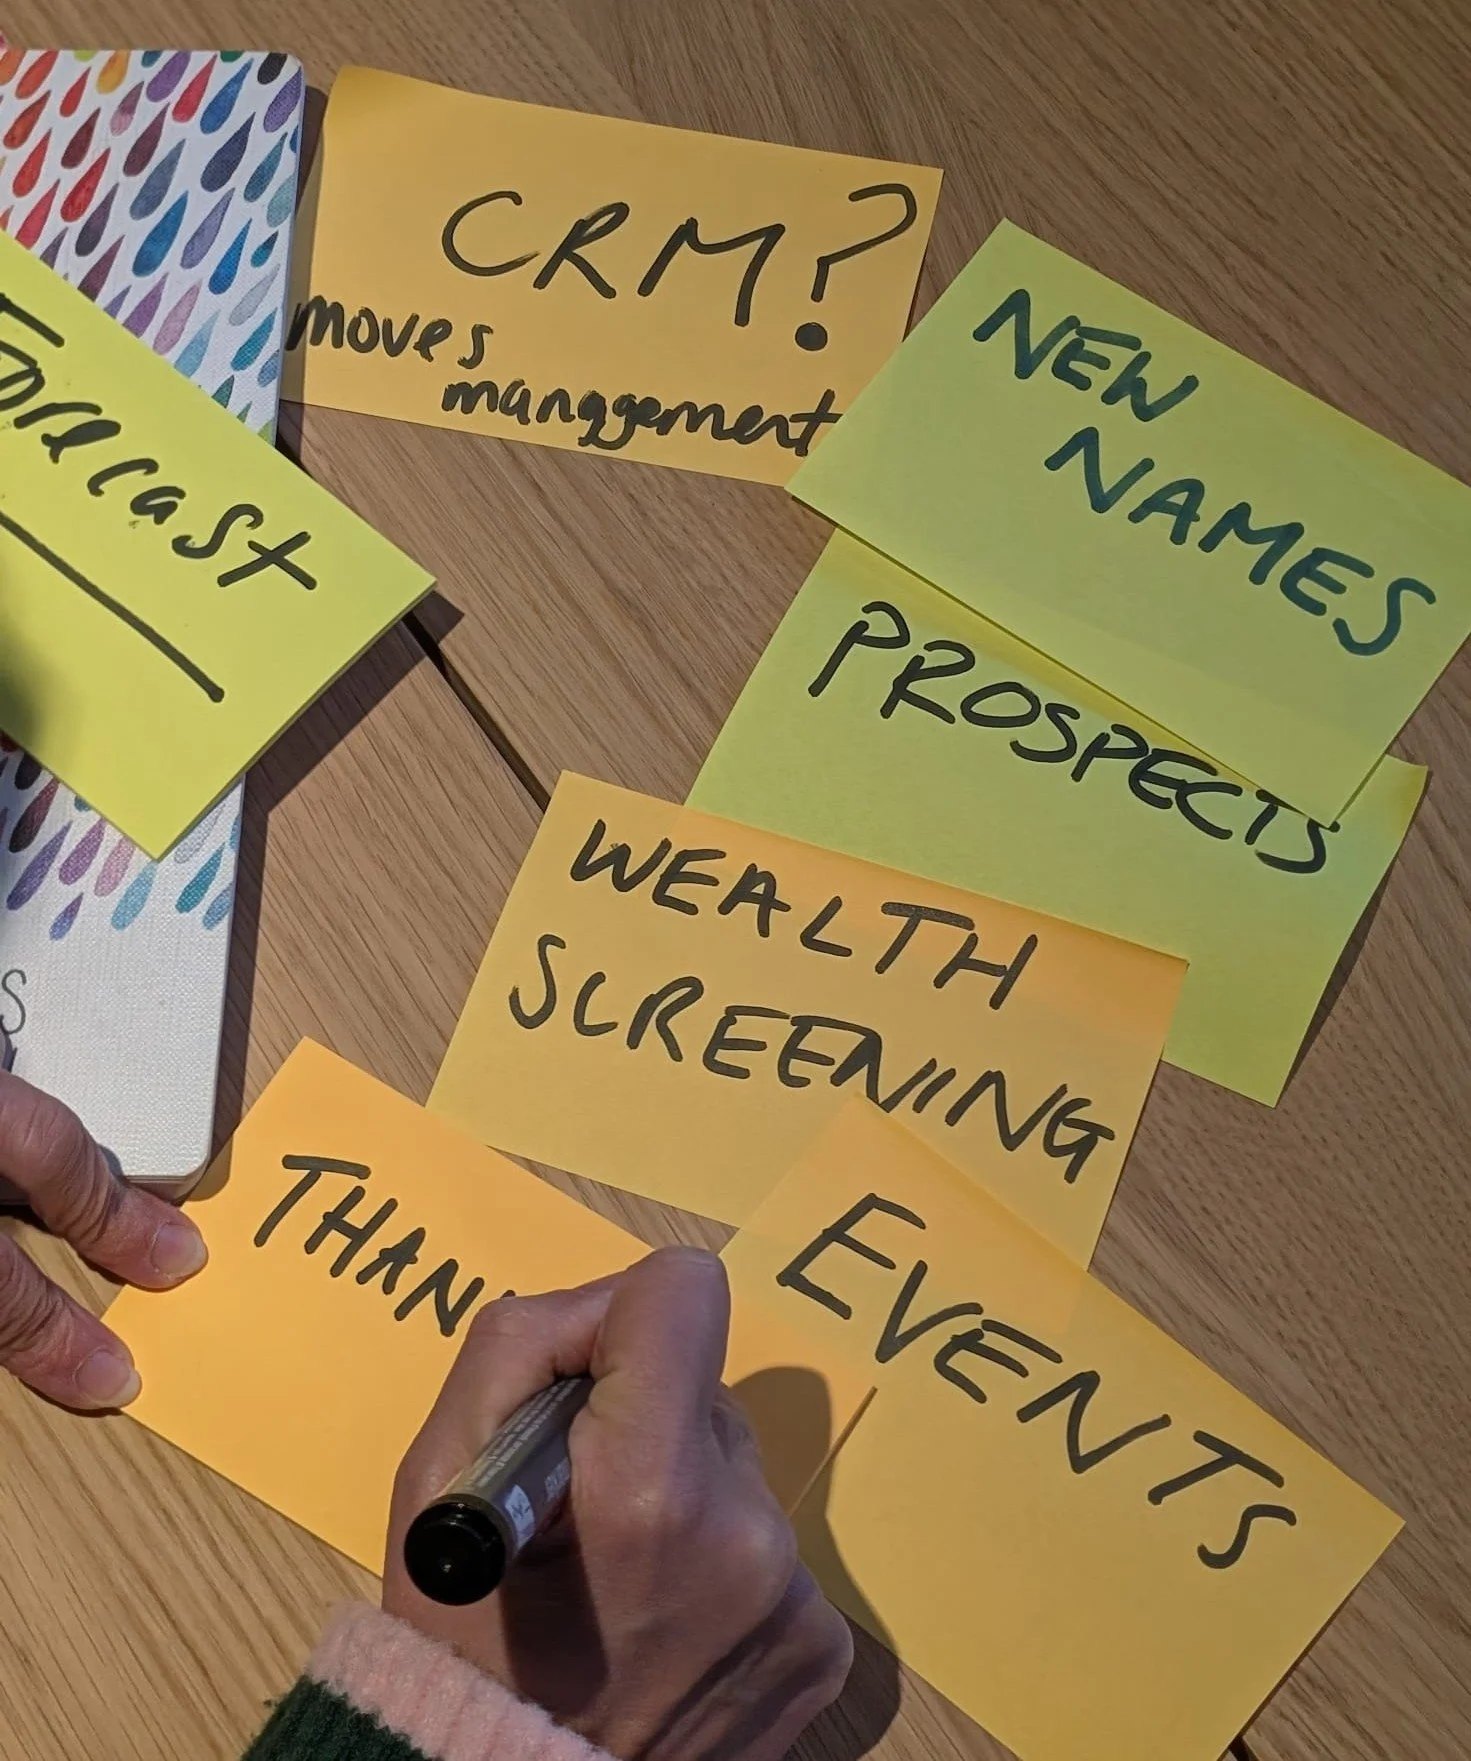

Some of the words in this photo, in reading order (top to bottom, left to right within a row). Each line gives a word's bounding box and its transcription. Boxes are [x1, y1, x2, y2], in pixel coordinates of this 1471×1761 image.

[284, 294, 494, 370] moves
[441, 183, 918, 352] CRM?
[972, 287, 1199, 422] NEW
[1044, 426, 1437, 656] NAMES
[807, 600, 1341, 874] PROSPECTS
[569, 818, 1039, 1010] WEALTH
[508, 933, 1116, 1184] SCREENING
[252, 1153, 517, 1338] THAN
[776, 1192, 1297, 1569] EVENTS
